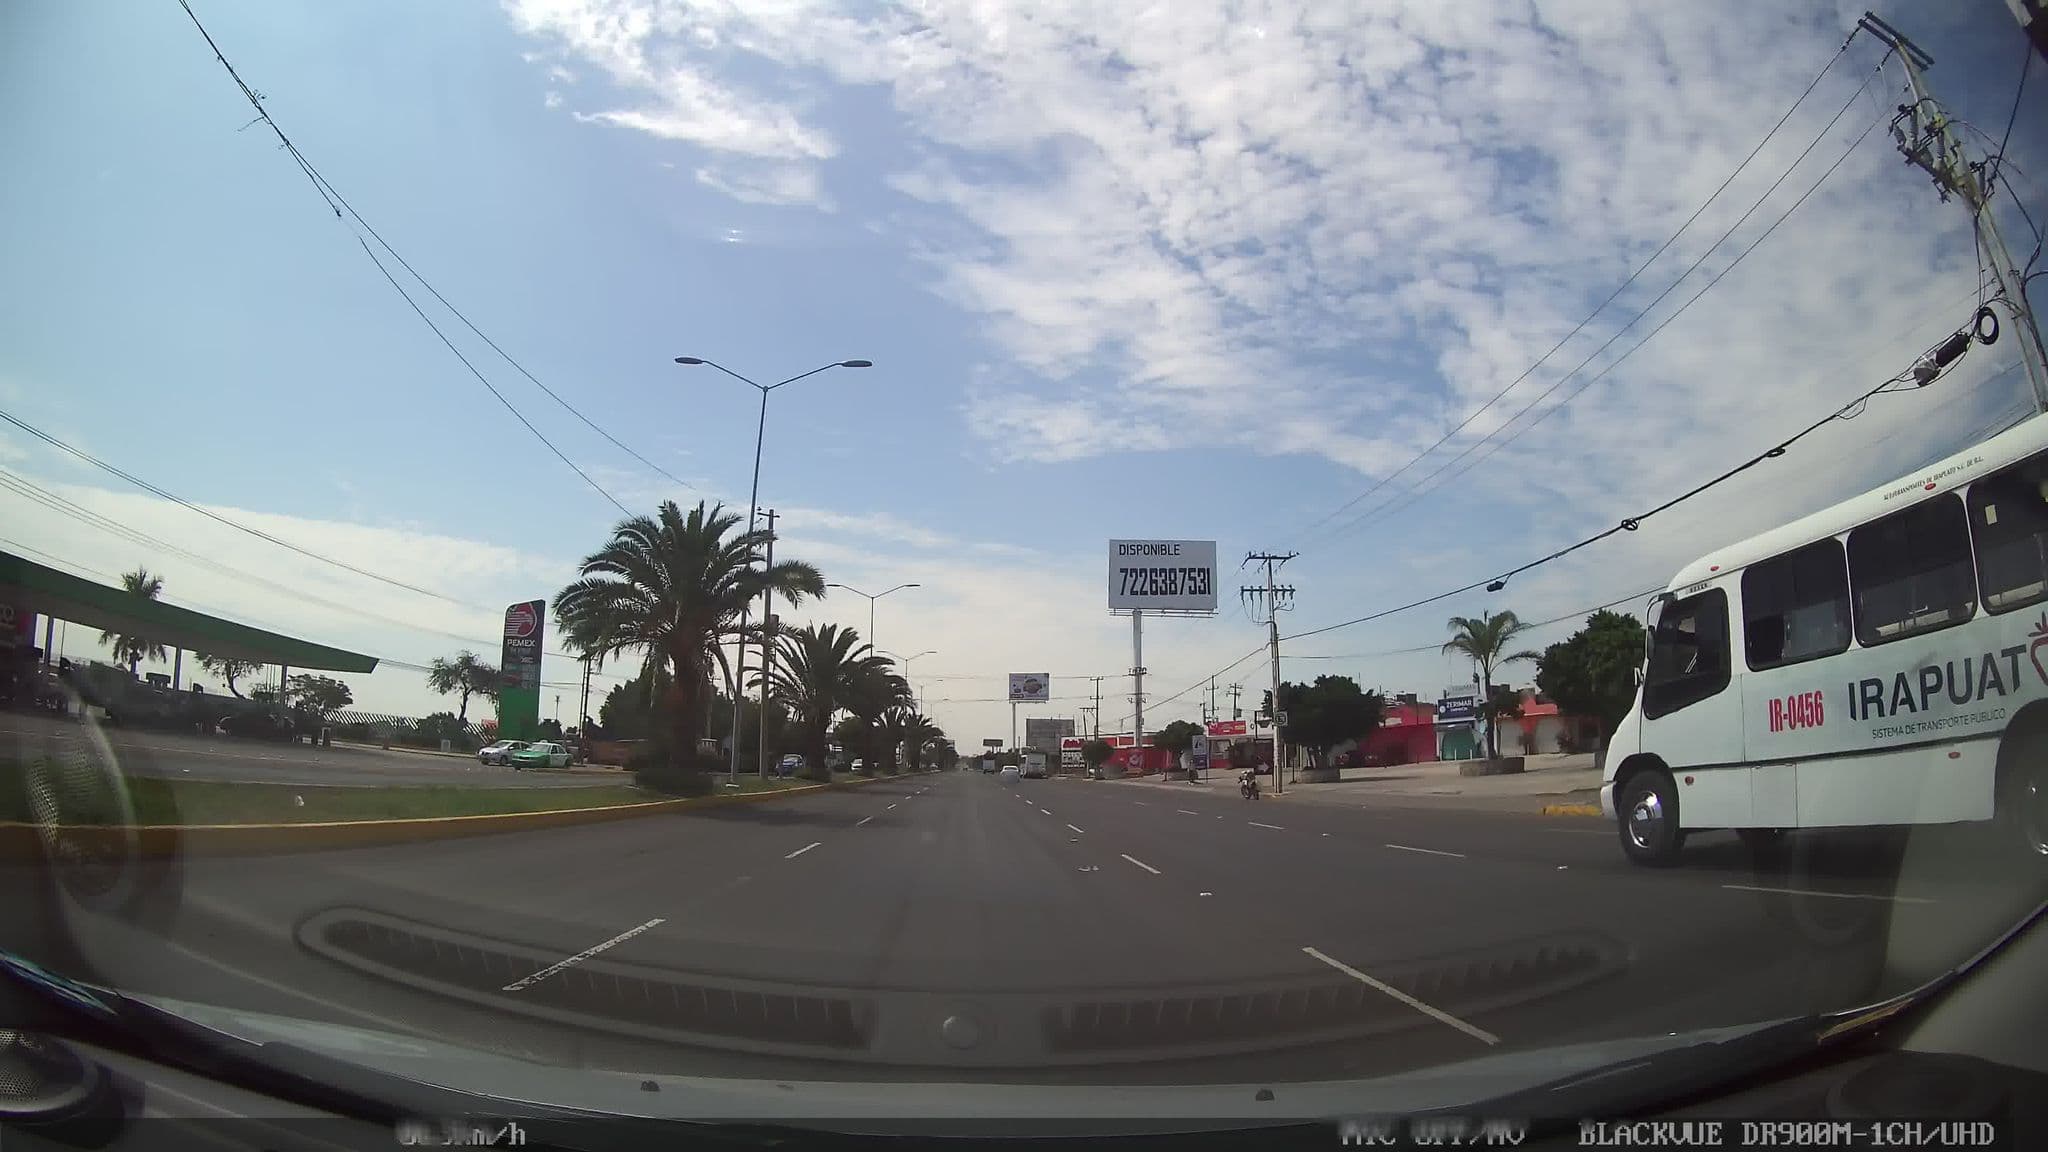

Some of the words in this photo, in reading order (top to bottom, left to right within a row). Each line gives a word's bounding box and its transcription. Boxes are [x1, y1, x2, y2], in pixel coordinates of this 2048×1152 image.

[1119, 544, 1181, 556] DISPONIBLE
[1119, 567, 1211, 596] 7226387531
[507, 639, 536, 647] PEMEX
[1446, 700, 1472, 708] ZERIMAR
[1769, 690, 1824, 732] IR-0456
[1872, 726, 1905, 739] SISTEMA
[1905, 724, 1916, 735] DE
[1918, 714, 1969, 732] TRANSPORTE
